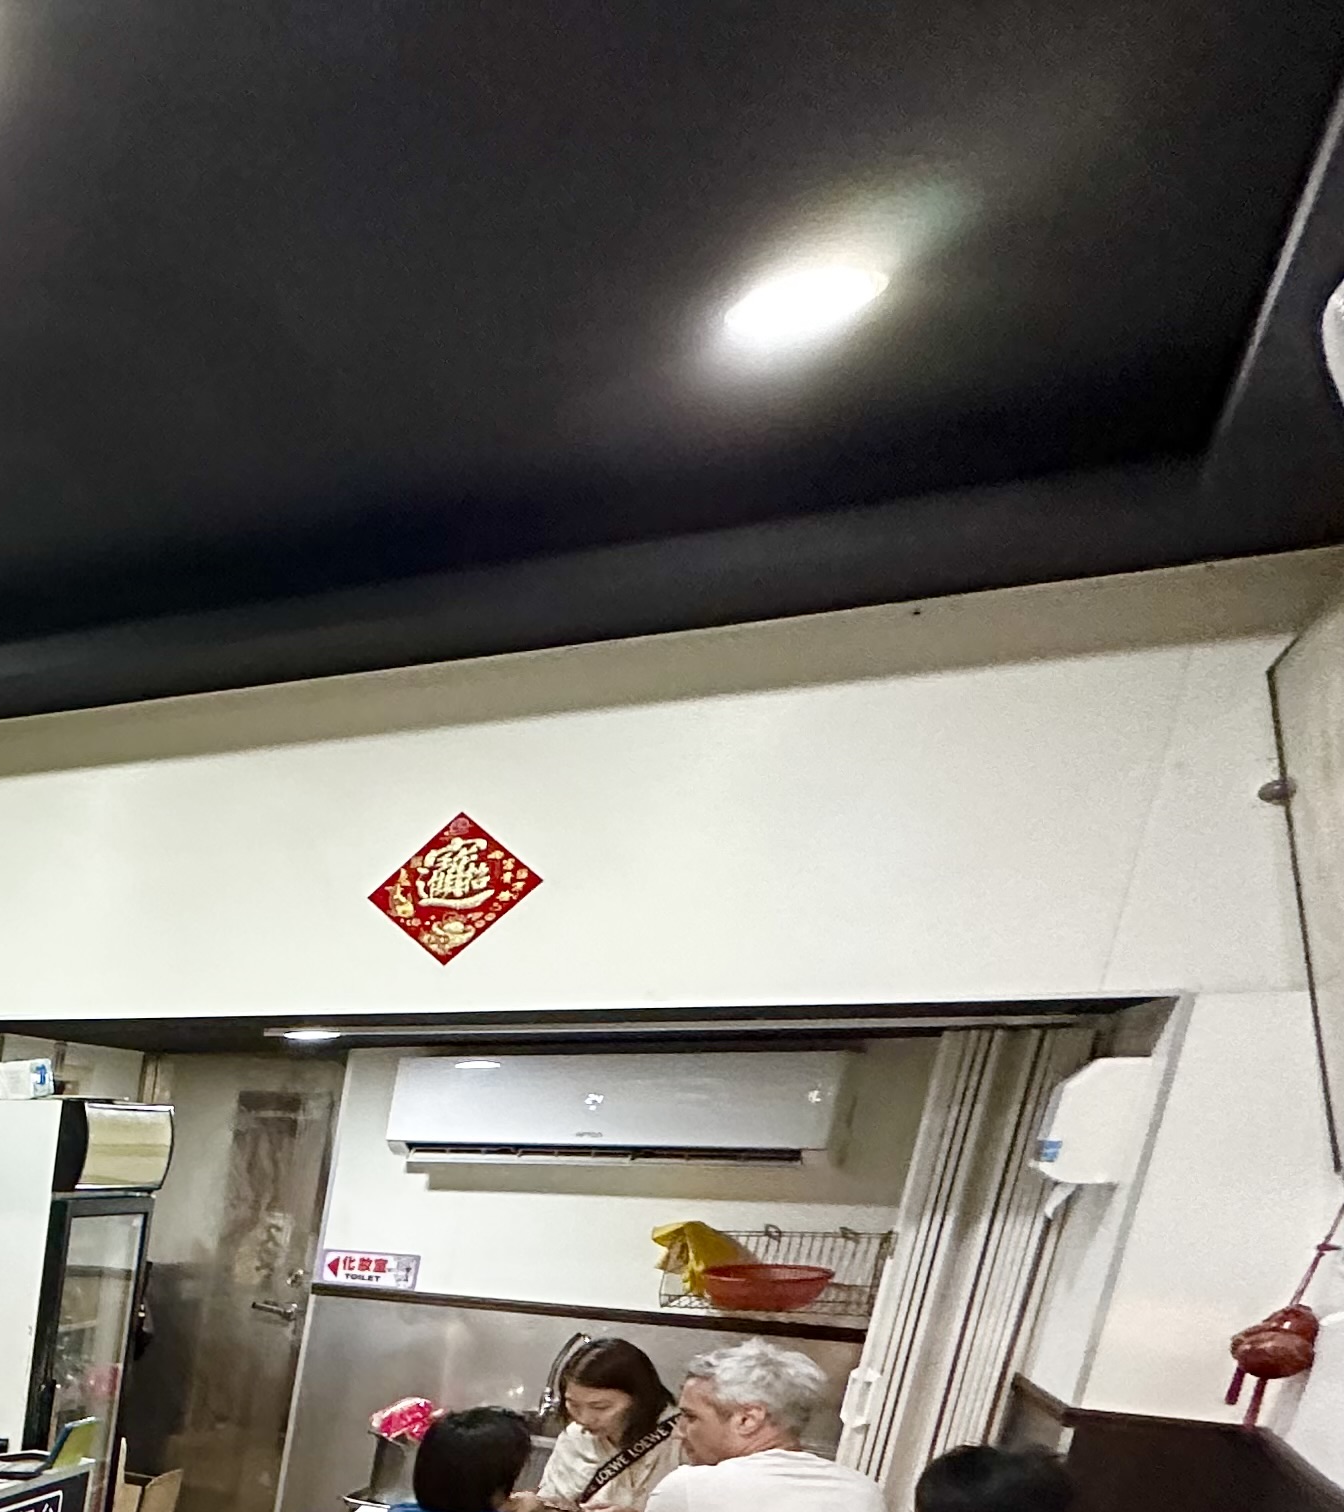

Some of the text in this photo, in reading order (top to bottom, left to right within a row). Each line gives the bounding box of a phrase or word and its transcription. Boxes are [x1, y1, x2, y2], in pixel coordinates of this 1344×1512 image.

[345, 1273, 381, 1282] TOILET
[595, 1428, 669, 1485] LOEWE LOEWE
